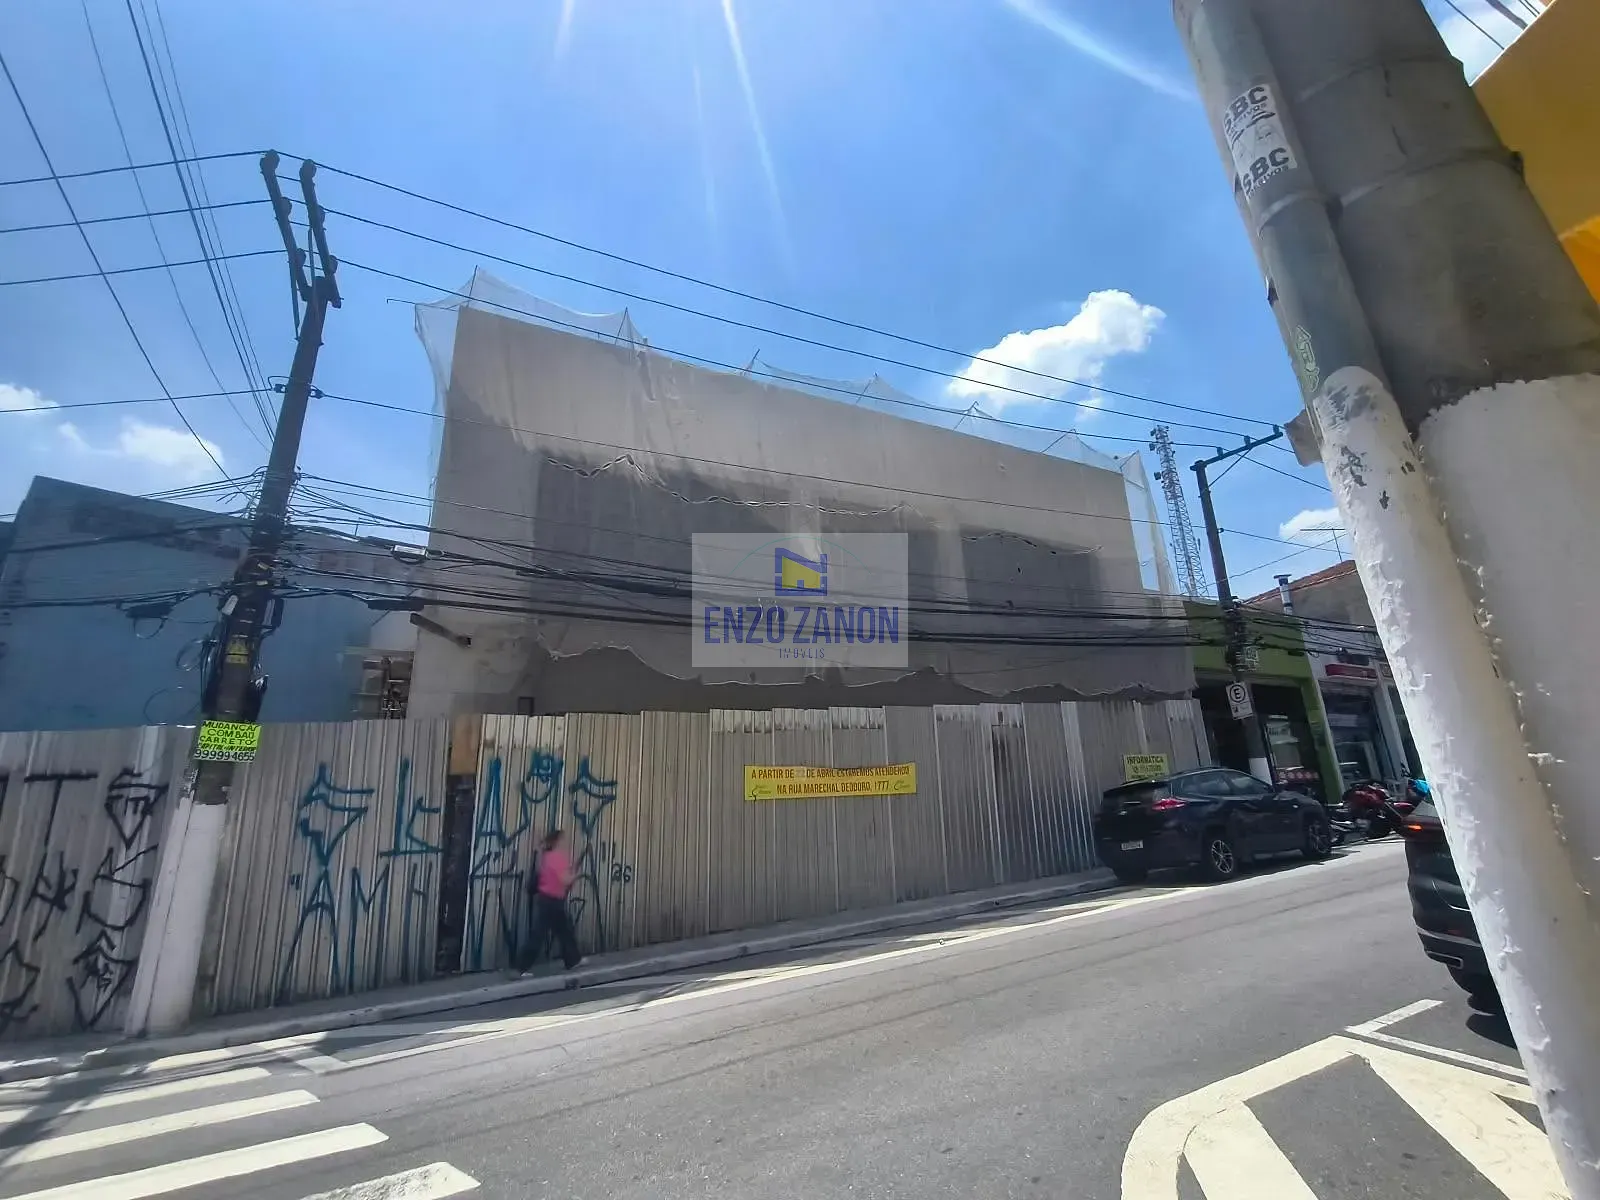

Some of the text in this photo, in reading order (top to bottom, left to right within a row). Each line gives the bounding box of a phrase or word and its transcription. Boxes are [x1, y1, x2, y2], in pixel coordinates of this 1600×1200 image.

[1224, 87, 1268, 134] SBC
[1243, 147, 1290, 195] SBC
[207, 729, 234, 737] COM
[751, 769, 757, 779] A
[758, 769, 784, 778] PARTIR
[785, 769, 795, 778] DE
[806, 769, 816, 777] DE
[816, 768, 835, 777] ABRIL
[836, 767, 874, 777] ESTAREMOS
[874, 766, 910, 776] ATENDENDO
[776, 784, 787, 794] NA
[788, 784, 803, 794] RUA
[803, 783, 841, 793] MARECHAL
[874, 780, 889, 790] 1777
